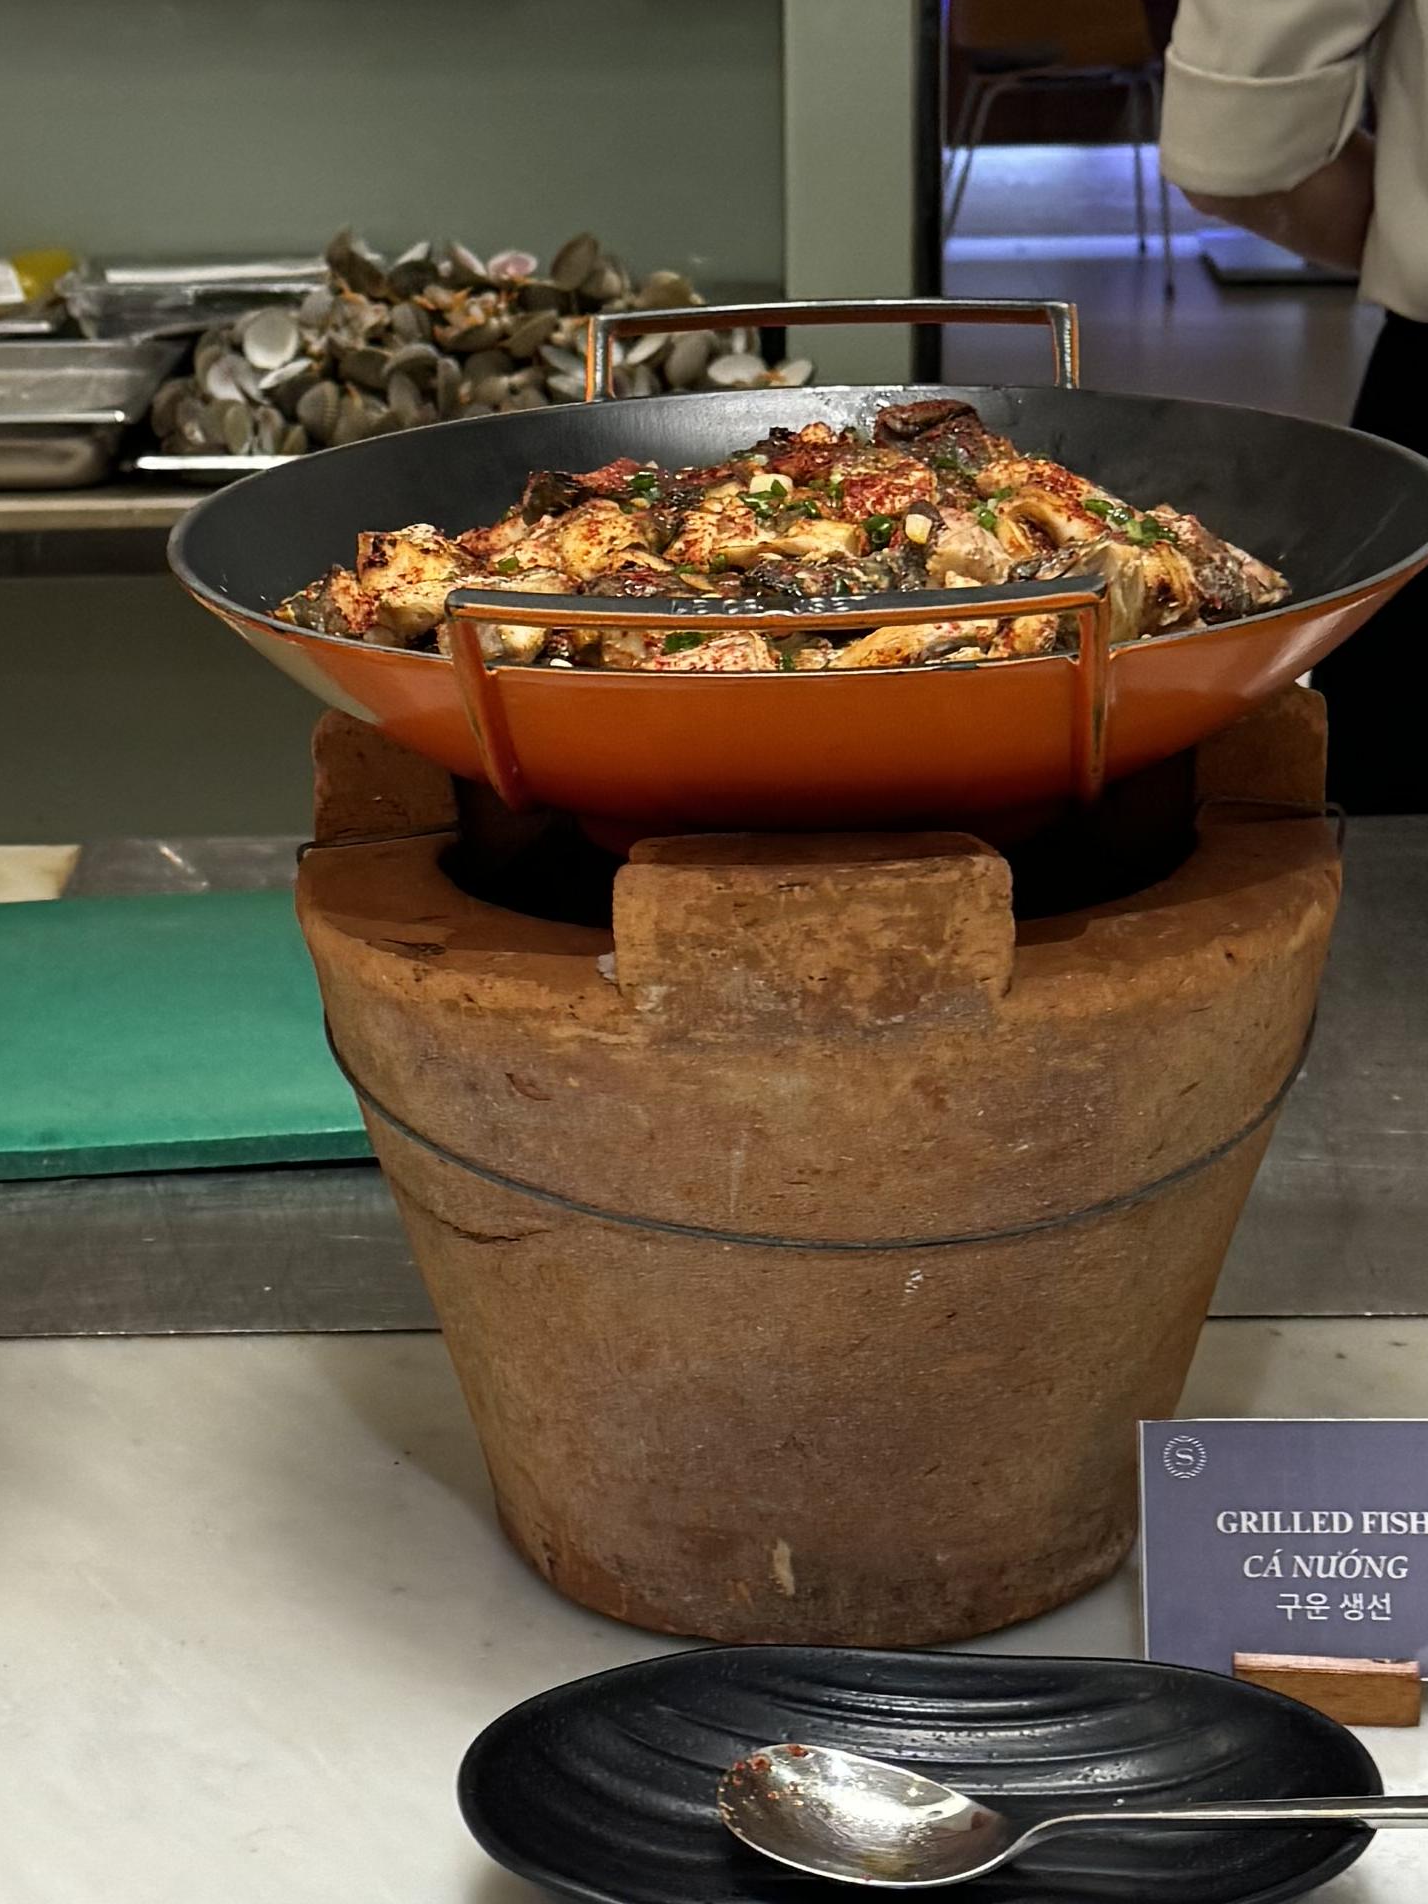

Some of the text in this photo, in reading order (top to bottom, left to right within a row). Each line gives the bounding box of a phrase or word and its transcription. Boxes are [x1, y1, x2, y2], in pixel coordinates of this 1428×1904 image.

[1216, 1510, 1354, 1535] GRILLED
[1243, 1548, 1285, 1579] CÁ
[1276, 1591, 1393, 1622] 구운 생선
